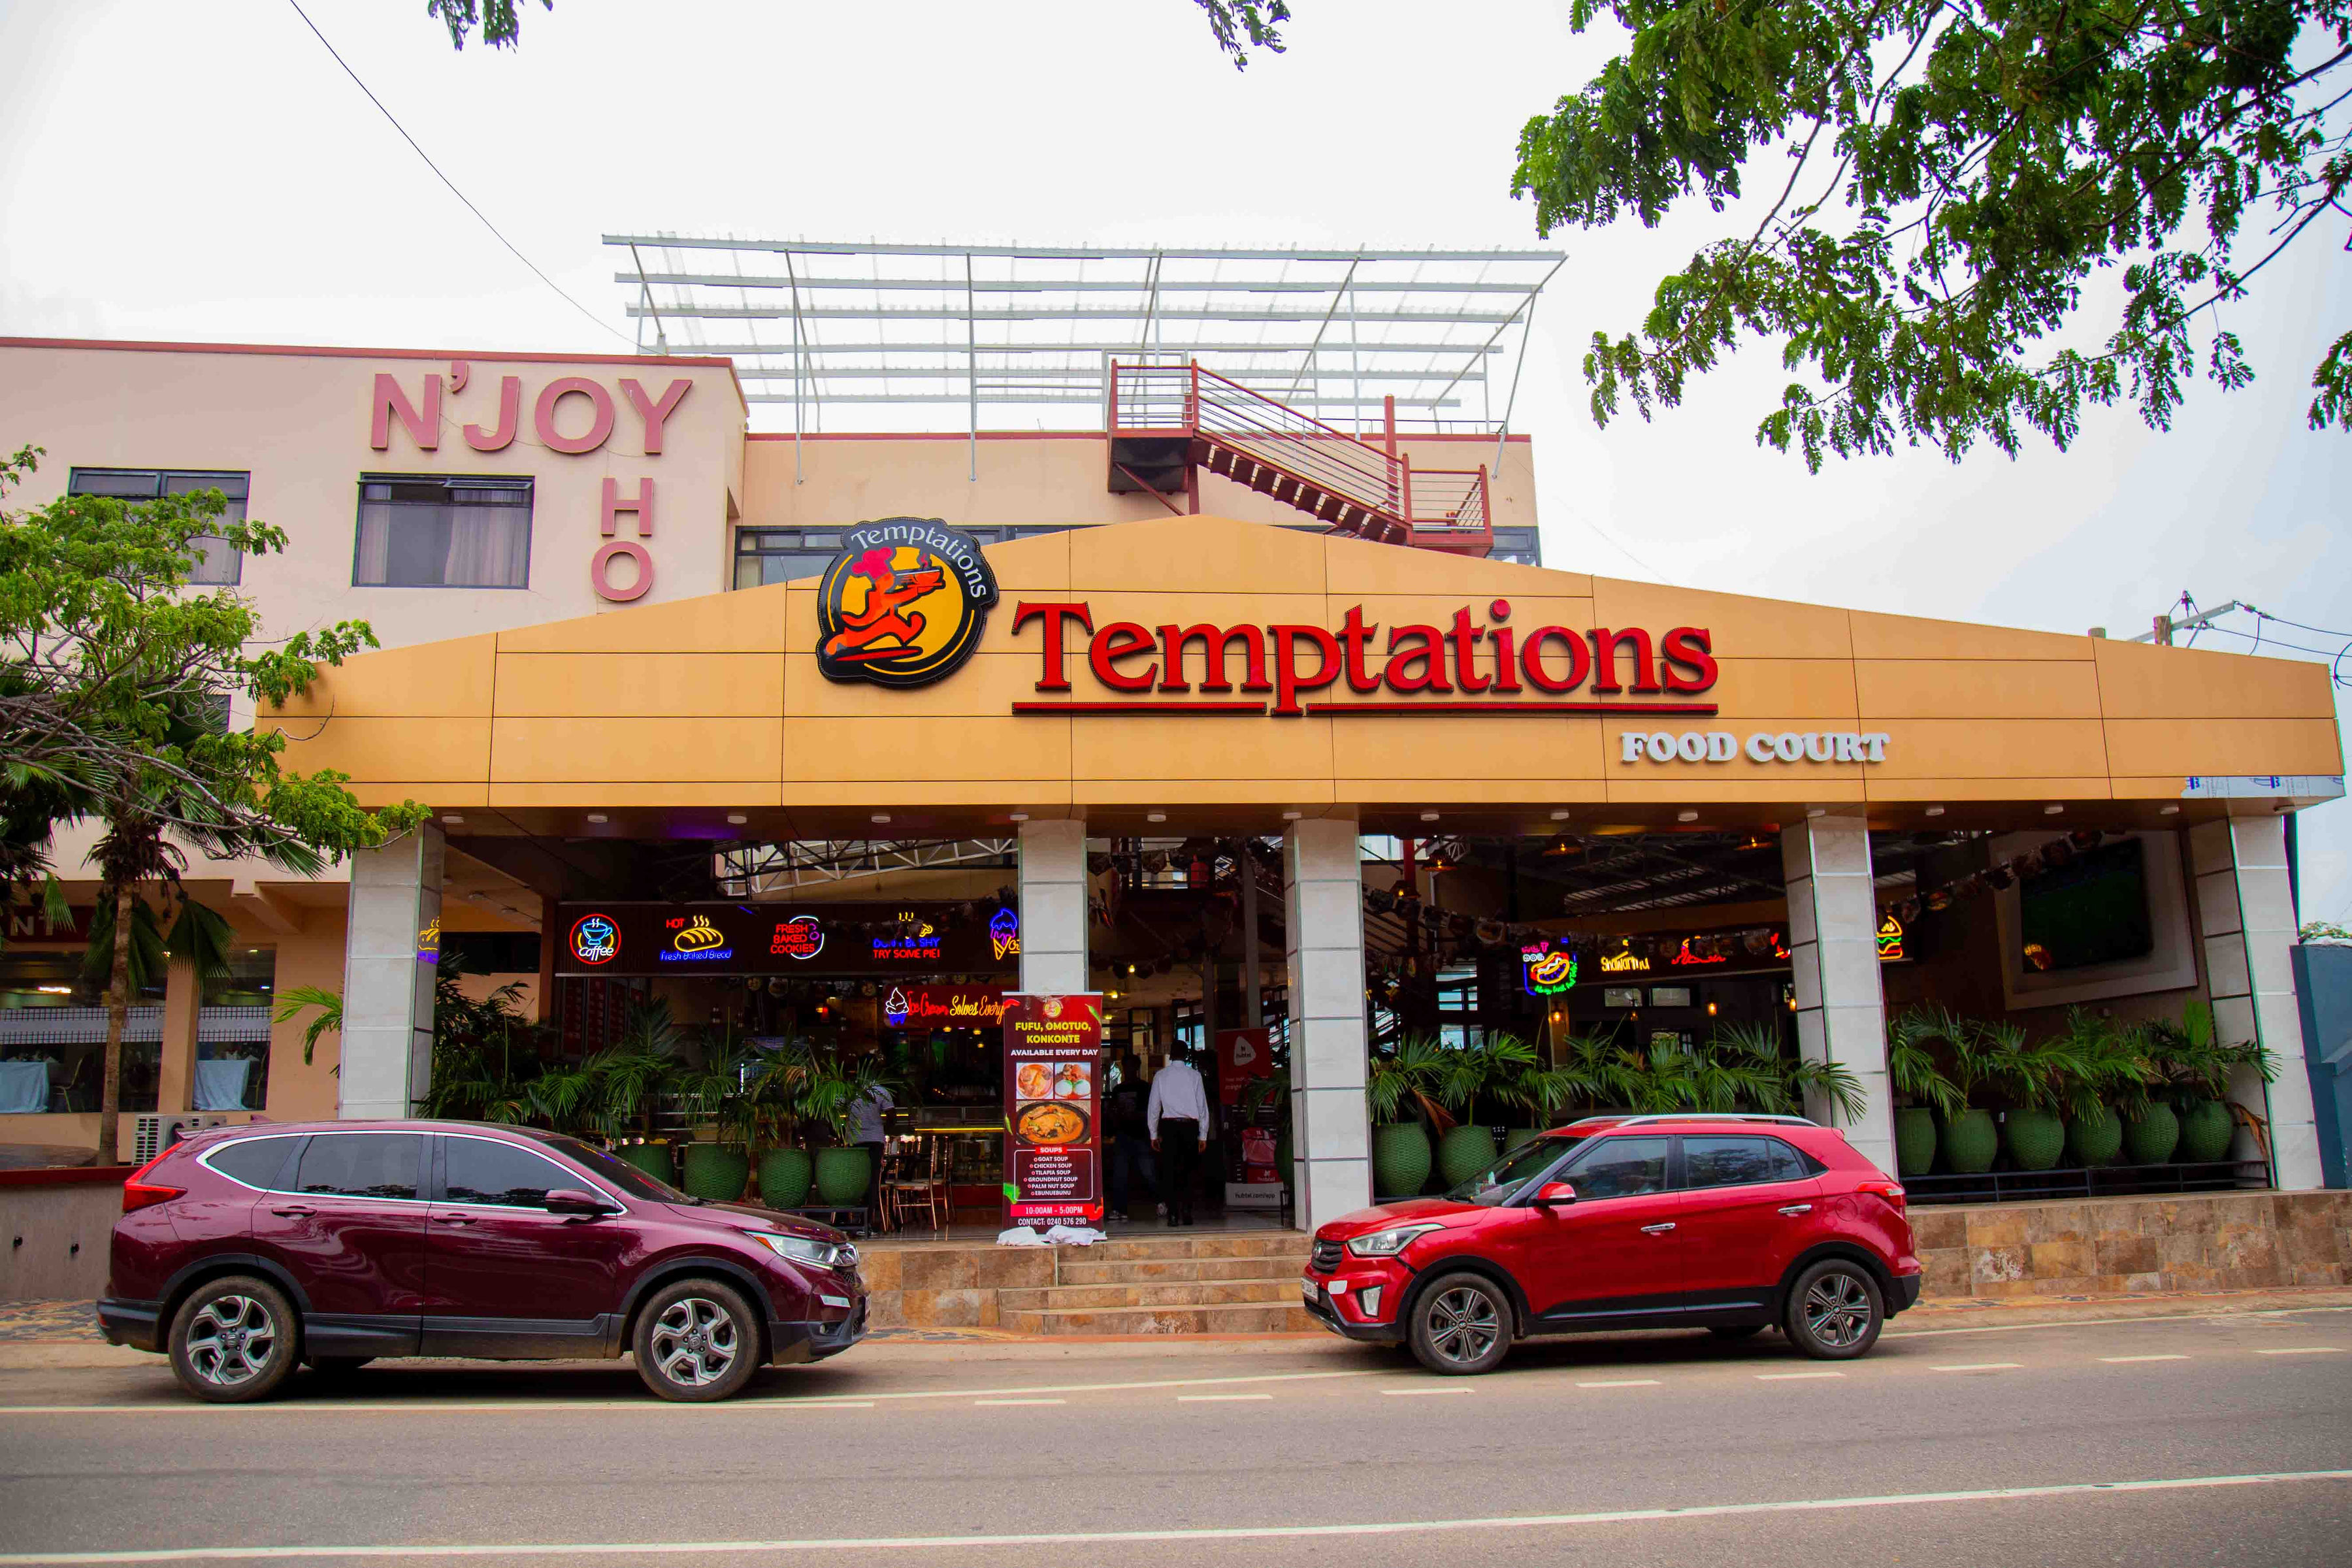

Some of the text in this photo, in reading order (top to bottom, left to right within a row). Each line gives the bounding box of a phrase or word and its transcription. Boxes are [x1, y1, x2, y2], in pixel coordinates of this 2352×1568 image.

[370, 361, 693, 455] N'JOY
[851, 525, 987, 598] Temptations
[1011, 598, 1718, 717] Temptations
[1621, 732, 1890, 763] FOOD COURT
[666, 918, 684, 928] HOT
[776, 923, 808, 933] FRESH
[774, 934, 808, 943] BAKED
[919, 938, 941, 947] SHY
[579, 945, 614, 961] Coffee
[770, 943, 815, 954] COOKIES
[873, 949, 891, 958] TRY
[893, 949, 922, 958] SOME
[661, 949, 732, 960] Fresh Baked Bread
[1523, 953, 1544, 962] DOG
[949, 994, 979, 1017] Solves
[1015, 1022, 1092, 1032] FUFU, OMOTUO,
[1026, 1034, 1081, 1044] KONKONTE
[1025, 1206, 1053, 1215] 10:00AM
[1018, 1217, 1046, 1226] CONTACT:
[1047, 1217, 1062, 1226] 0240
[1075, 1217, 1086, 1225] 290
